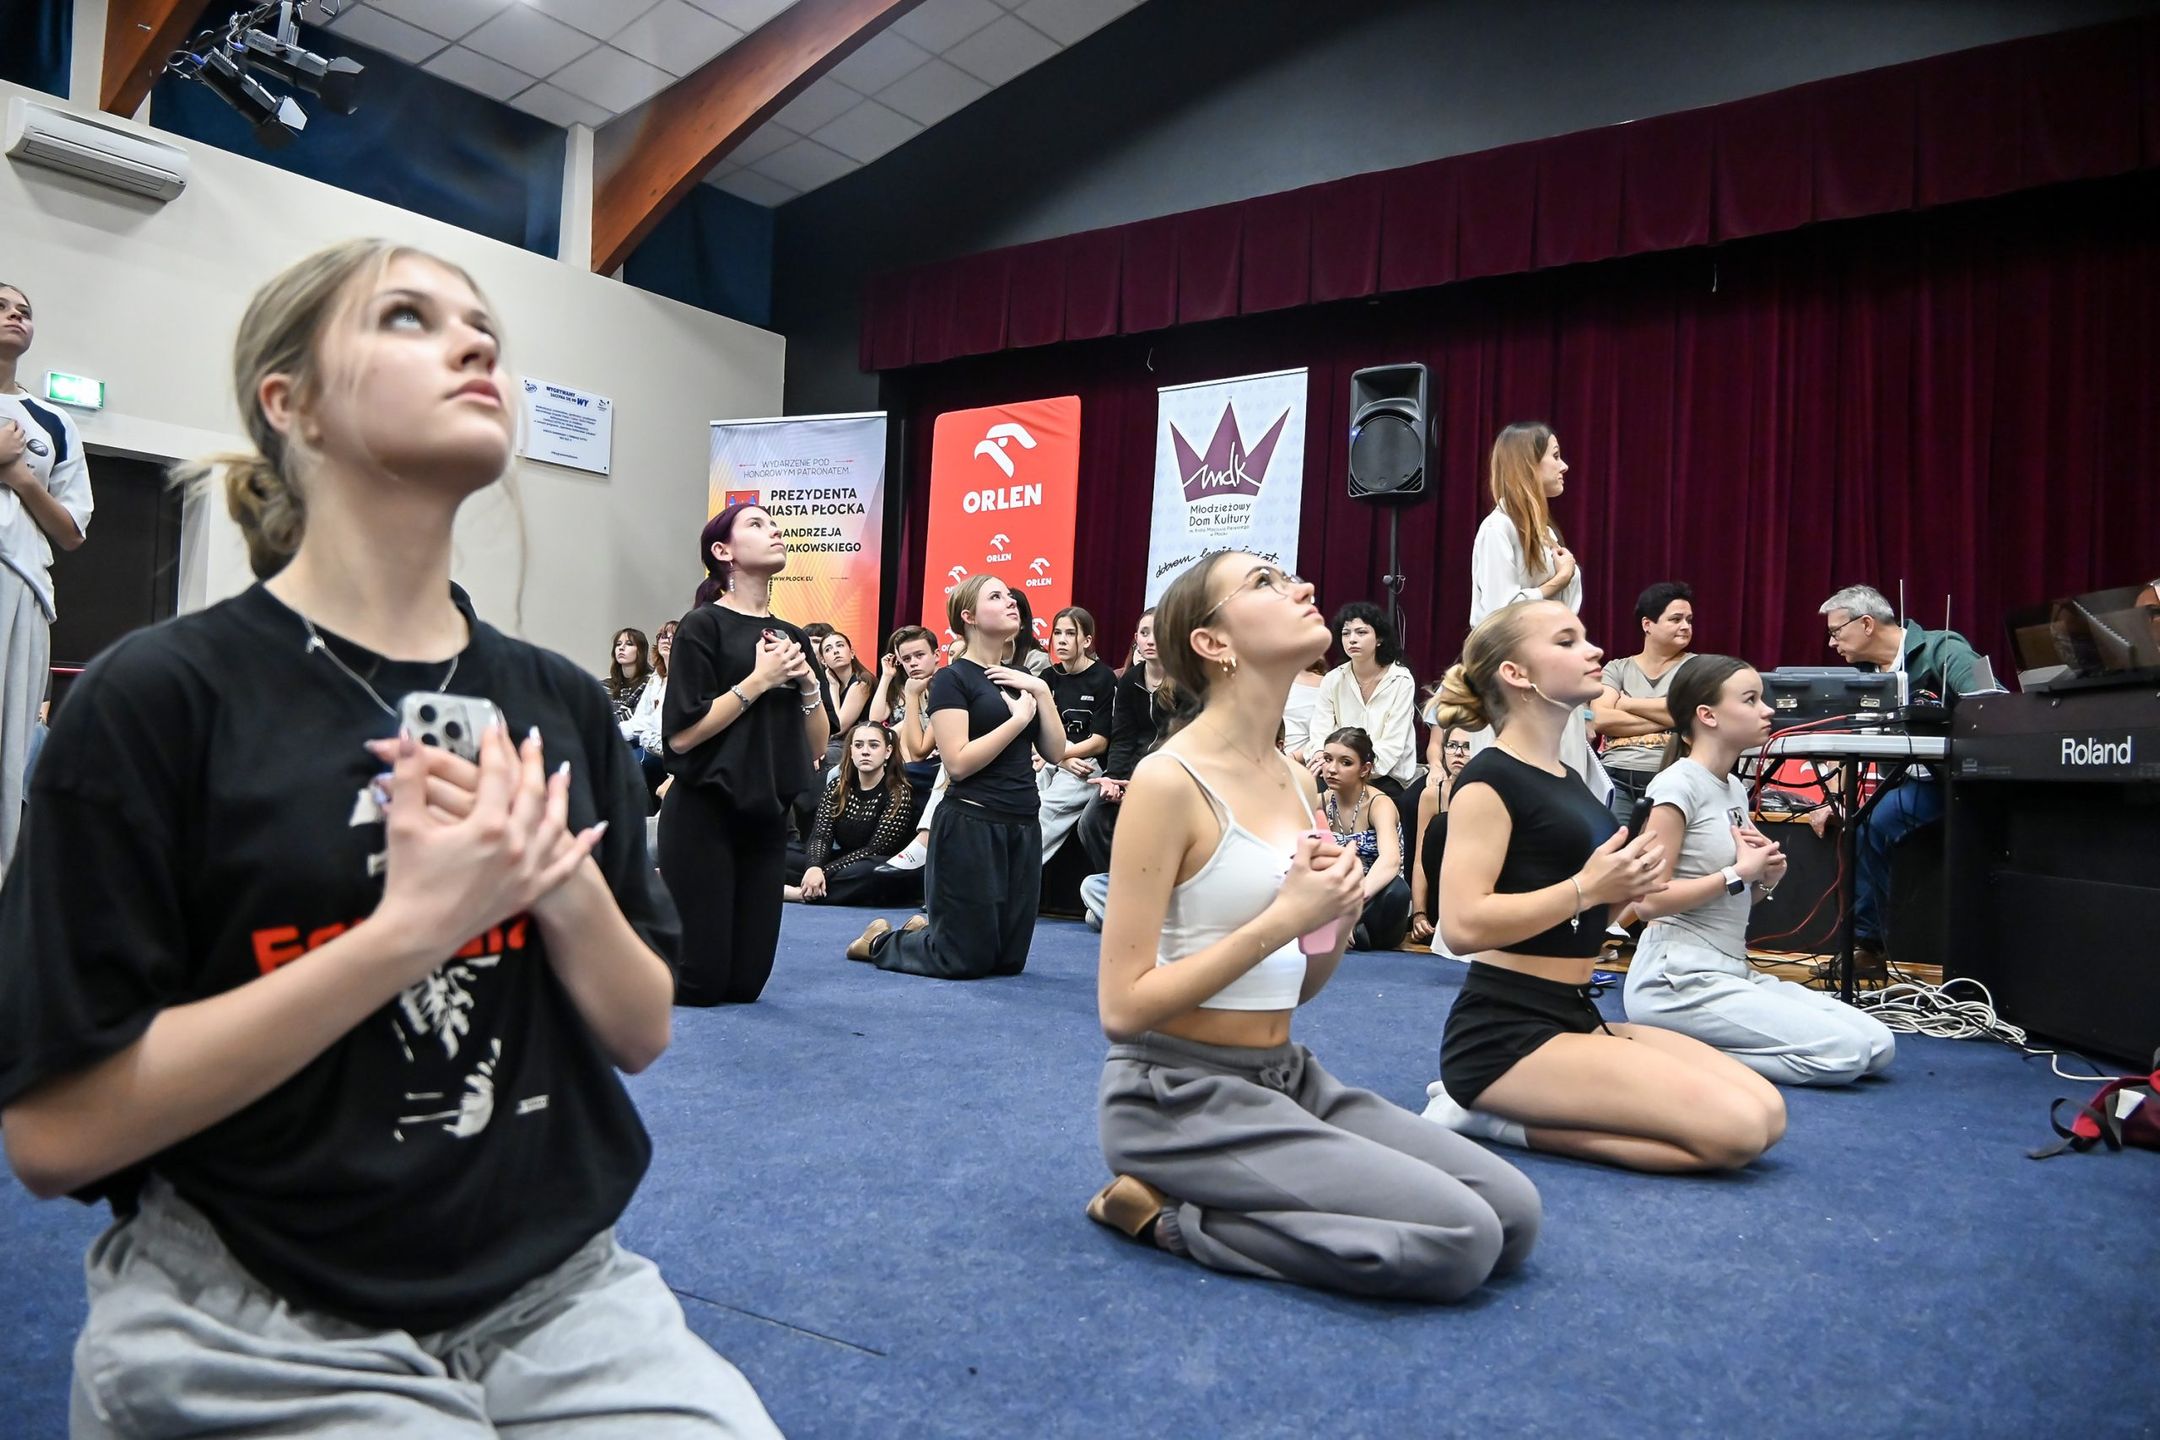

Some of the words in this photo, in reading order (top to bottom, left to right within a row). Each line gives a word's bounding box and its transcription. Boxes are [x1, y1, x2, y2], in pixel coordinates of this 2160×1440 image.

[577, 397, 589, 407] WY
[762, 458, 811, 468] WYDARZENIE
[812, 458, 830, 466] POD
[743, 469, 796, 478] HONOROWYM
[770, 488, 857, 501] PREZYDENTA
[963, 483, 1042, 513] ORLEN
[811, 503, 865, 516] PŁOCKA
[1190, 503, 1251, 514] Młodzieżowy
[1189, 516, 1211, 526] Dom
[1214, 513, 1250, 524] Kultury
[782, 527, 842, 538] ANDRZEJA
[986, 553, 1012, 562] ORLEN
[1025, 578, 1052, 587] ORLEN
[2061, 735, 2132, 766] Roland
